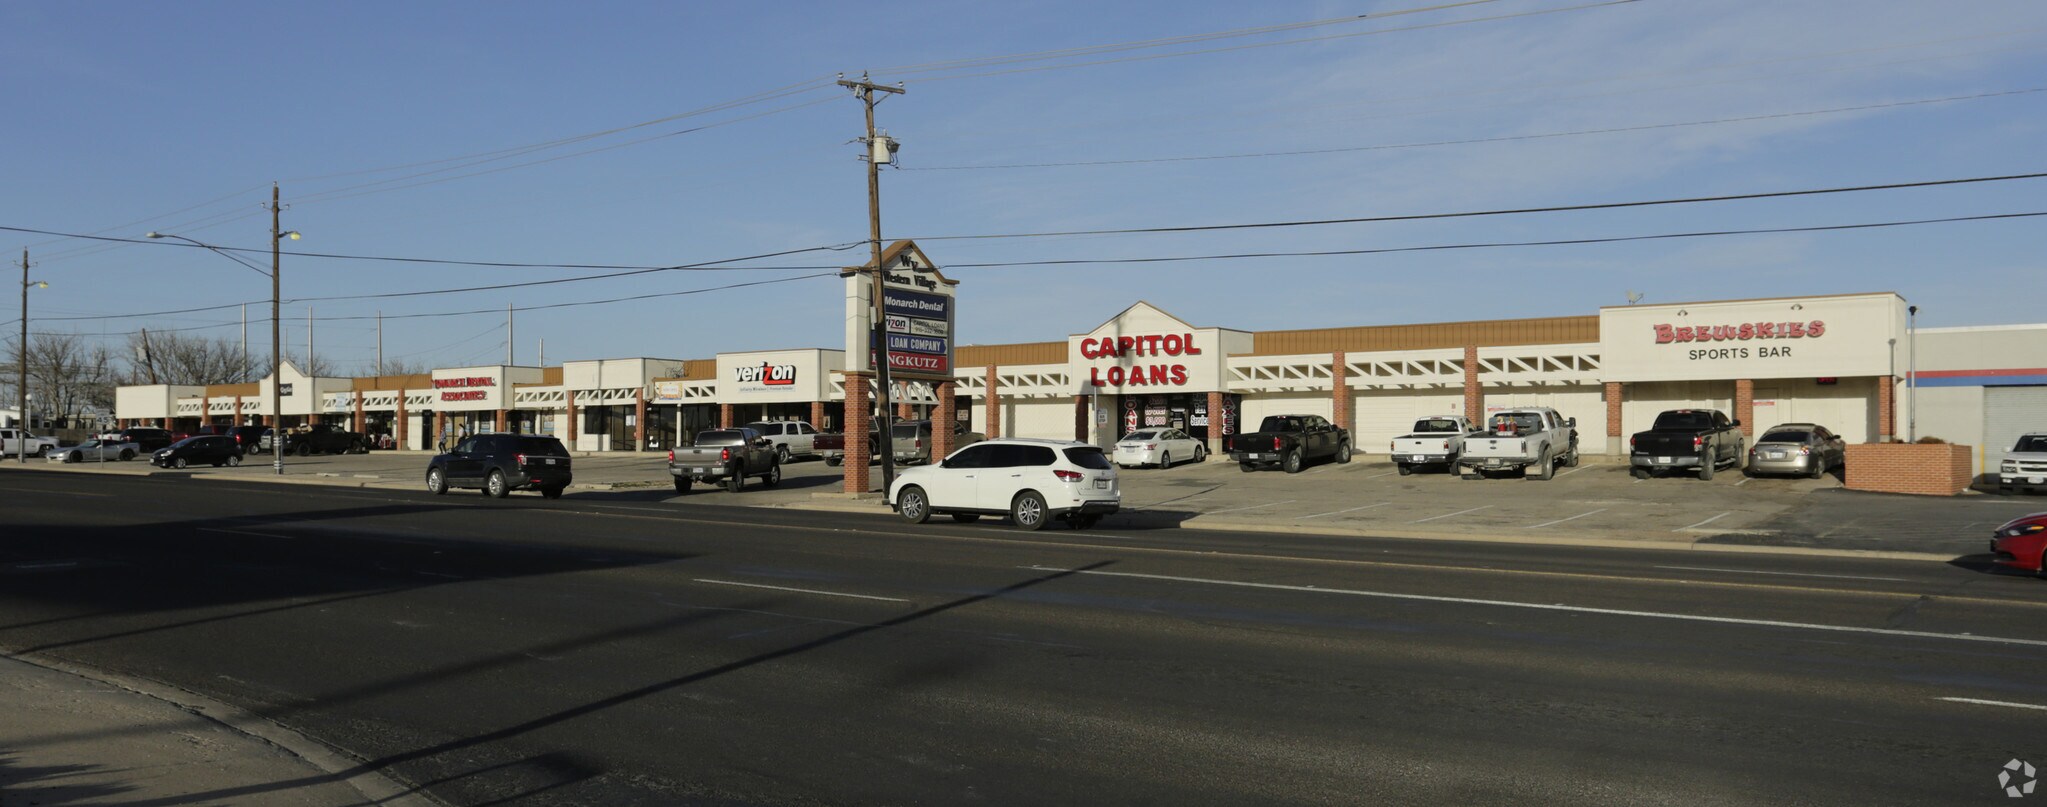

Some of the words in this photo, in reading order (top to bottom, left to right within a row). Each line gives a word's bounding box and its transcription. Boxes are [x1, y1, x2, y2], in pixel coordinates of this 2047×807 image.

[884, 271, 910, 285] Western
[914, 275, 937, 292] Village
[885, 296, 918, 309] Monarch
[919, 300, 944, 312] Dental
[1653, 320, 1826, 344] BREWSKIES
[891, 337, 908, 348] LOAN
[911, 339, 941, 351] COMPANY
[1080, 333, 1202, 360] CAPITOL
[1689, 348, 1749, 361] SPORTS
[1759, 346, 1792, 358] BAR
[872, 353, 938, 368] NGKUTZ
[735, 361, 796, 385] verizon
[1091, 364, 1188, 387] LOANS
